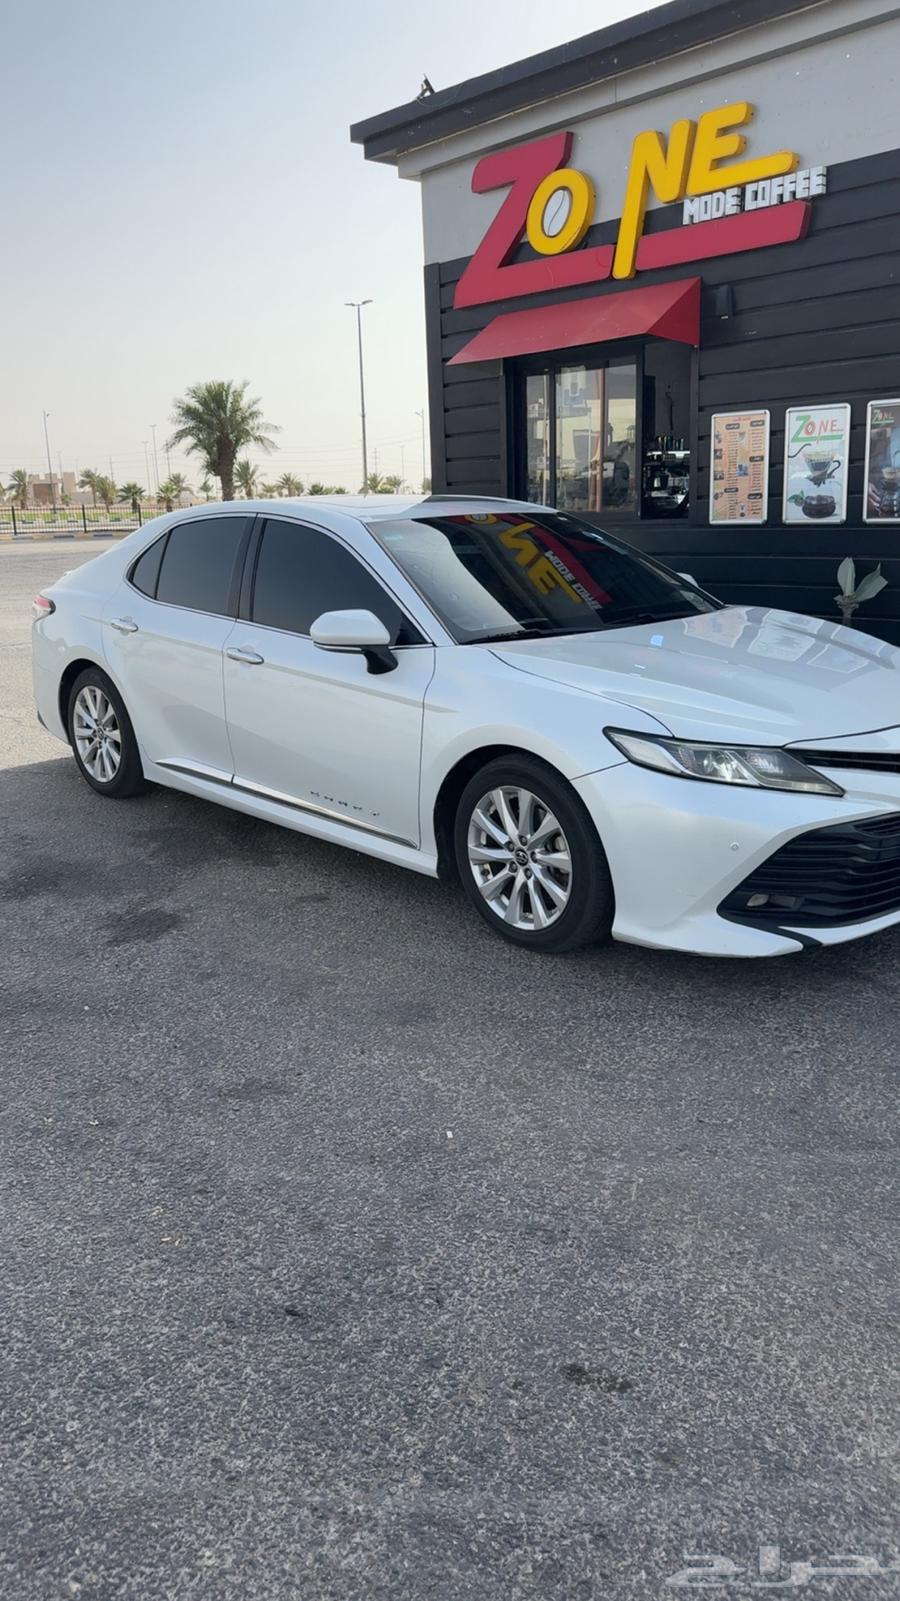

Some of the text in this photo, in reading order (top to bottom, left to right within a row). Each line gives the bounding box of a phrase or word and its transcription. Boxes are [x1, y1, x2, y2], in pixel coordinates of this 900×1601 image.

[453, 101, 813, 310] ZONE
[682, 166, 828, 225] MODE COFFEE
[791, 414, 845, 444] ZONE
